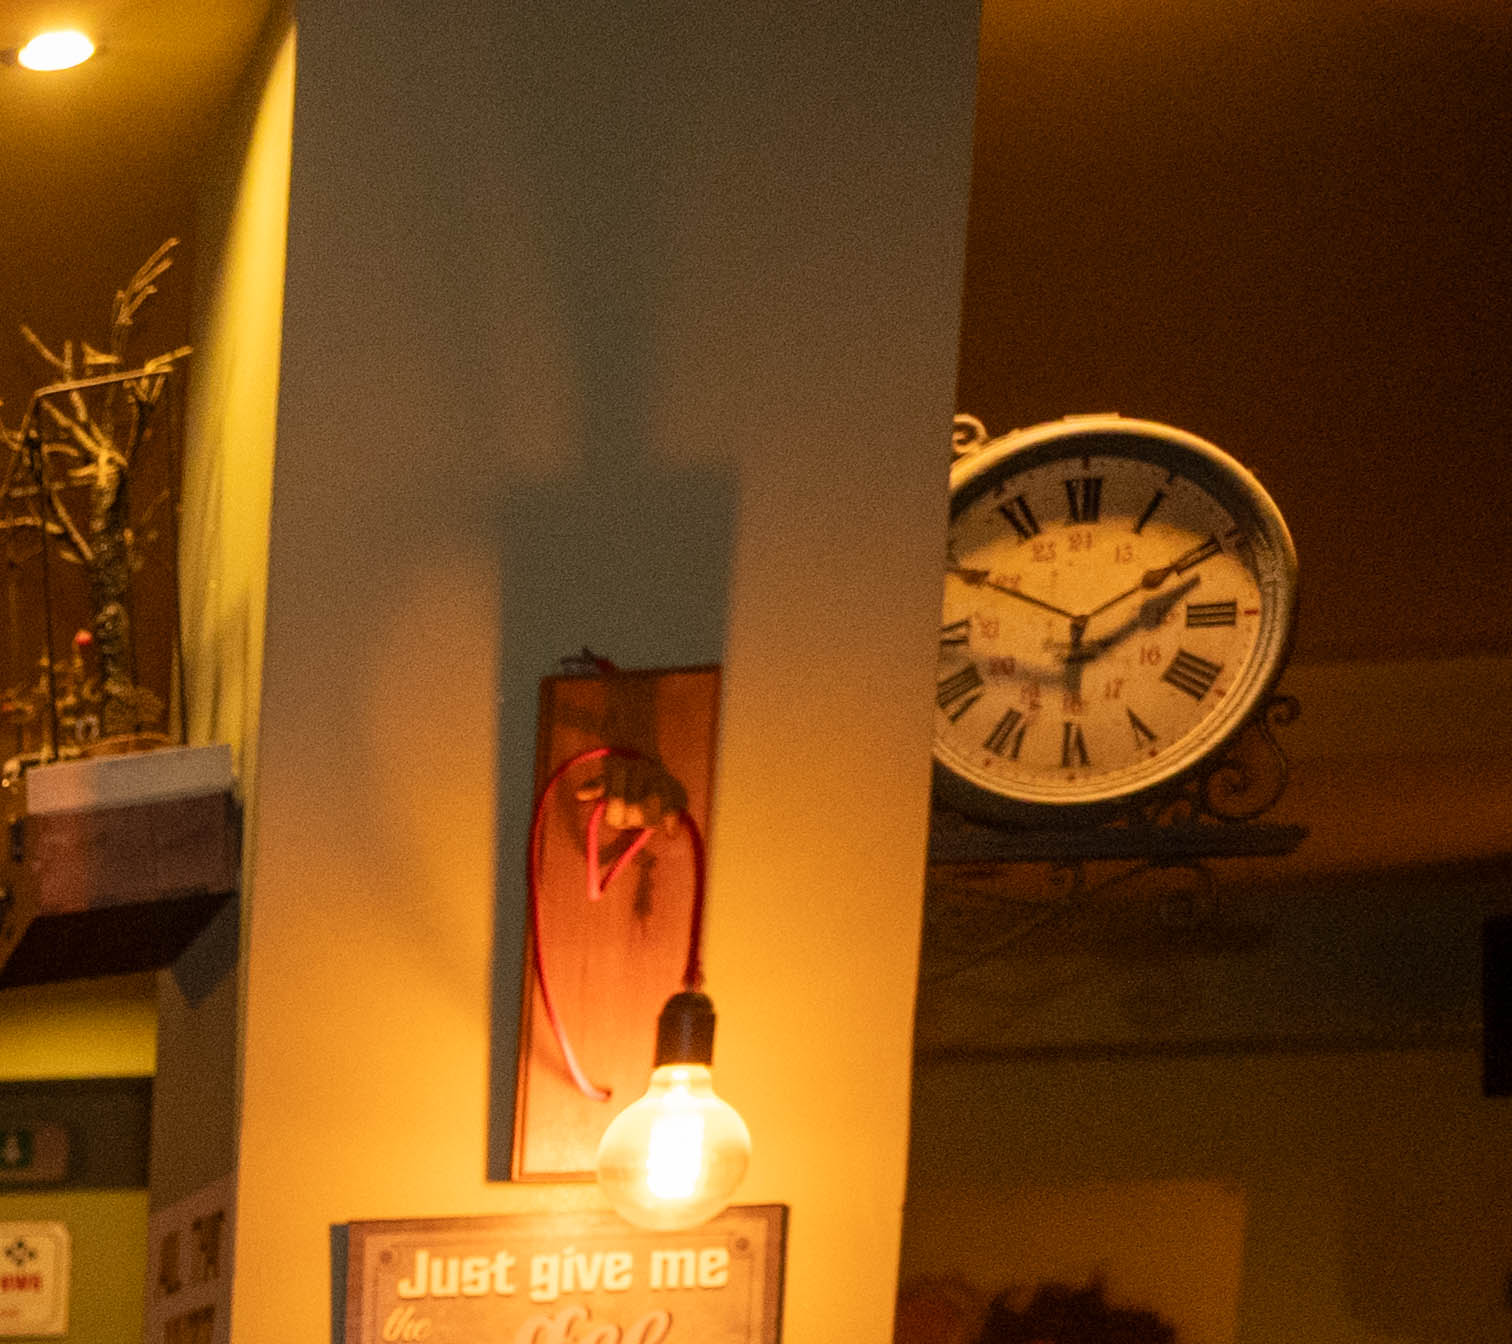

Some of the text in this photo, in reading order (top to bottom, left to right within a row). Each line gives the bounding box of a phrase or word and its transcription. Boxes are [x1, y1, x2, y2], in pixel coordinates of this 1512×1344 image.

[398, 1246, 729, 1301] Just give me
[381, 1307, 433, 1343] the
